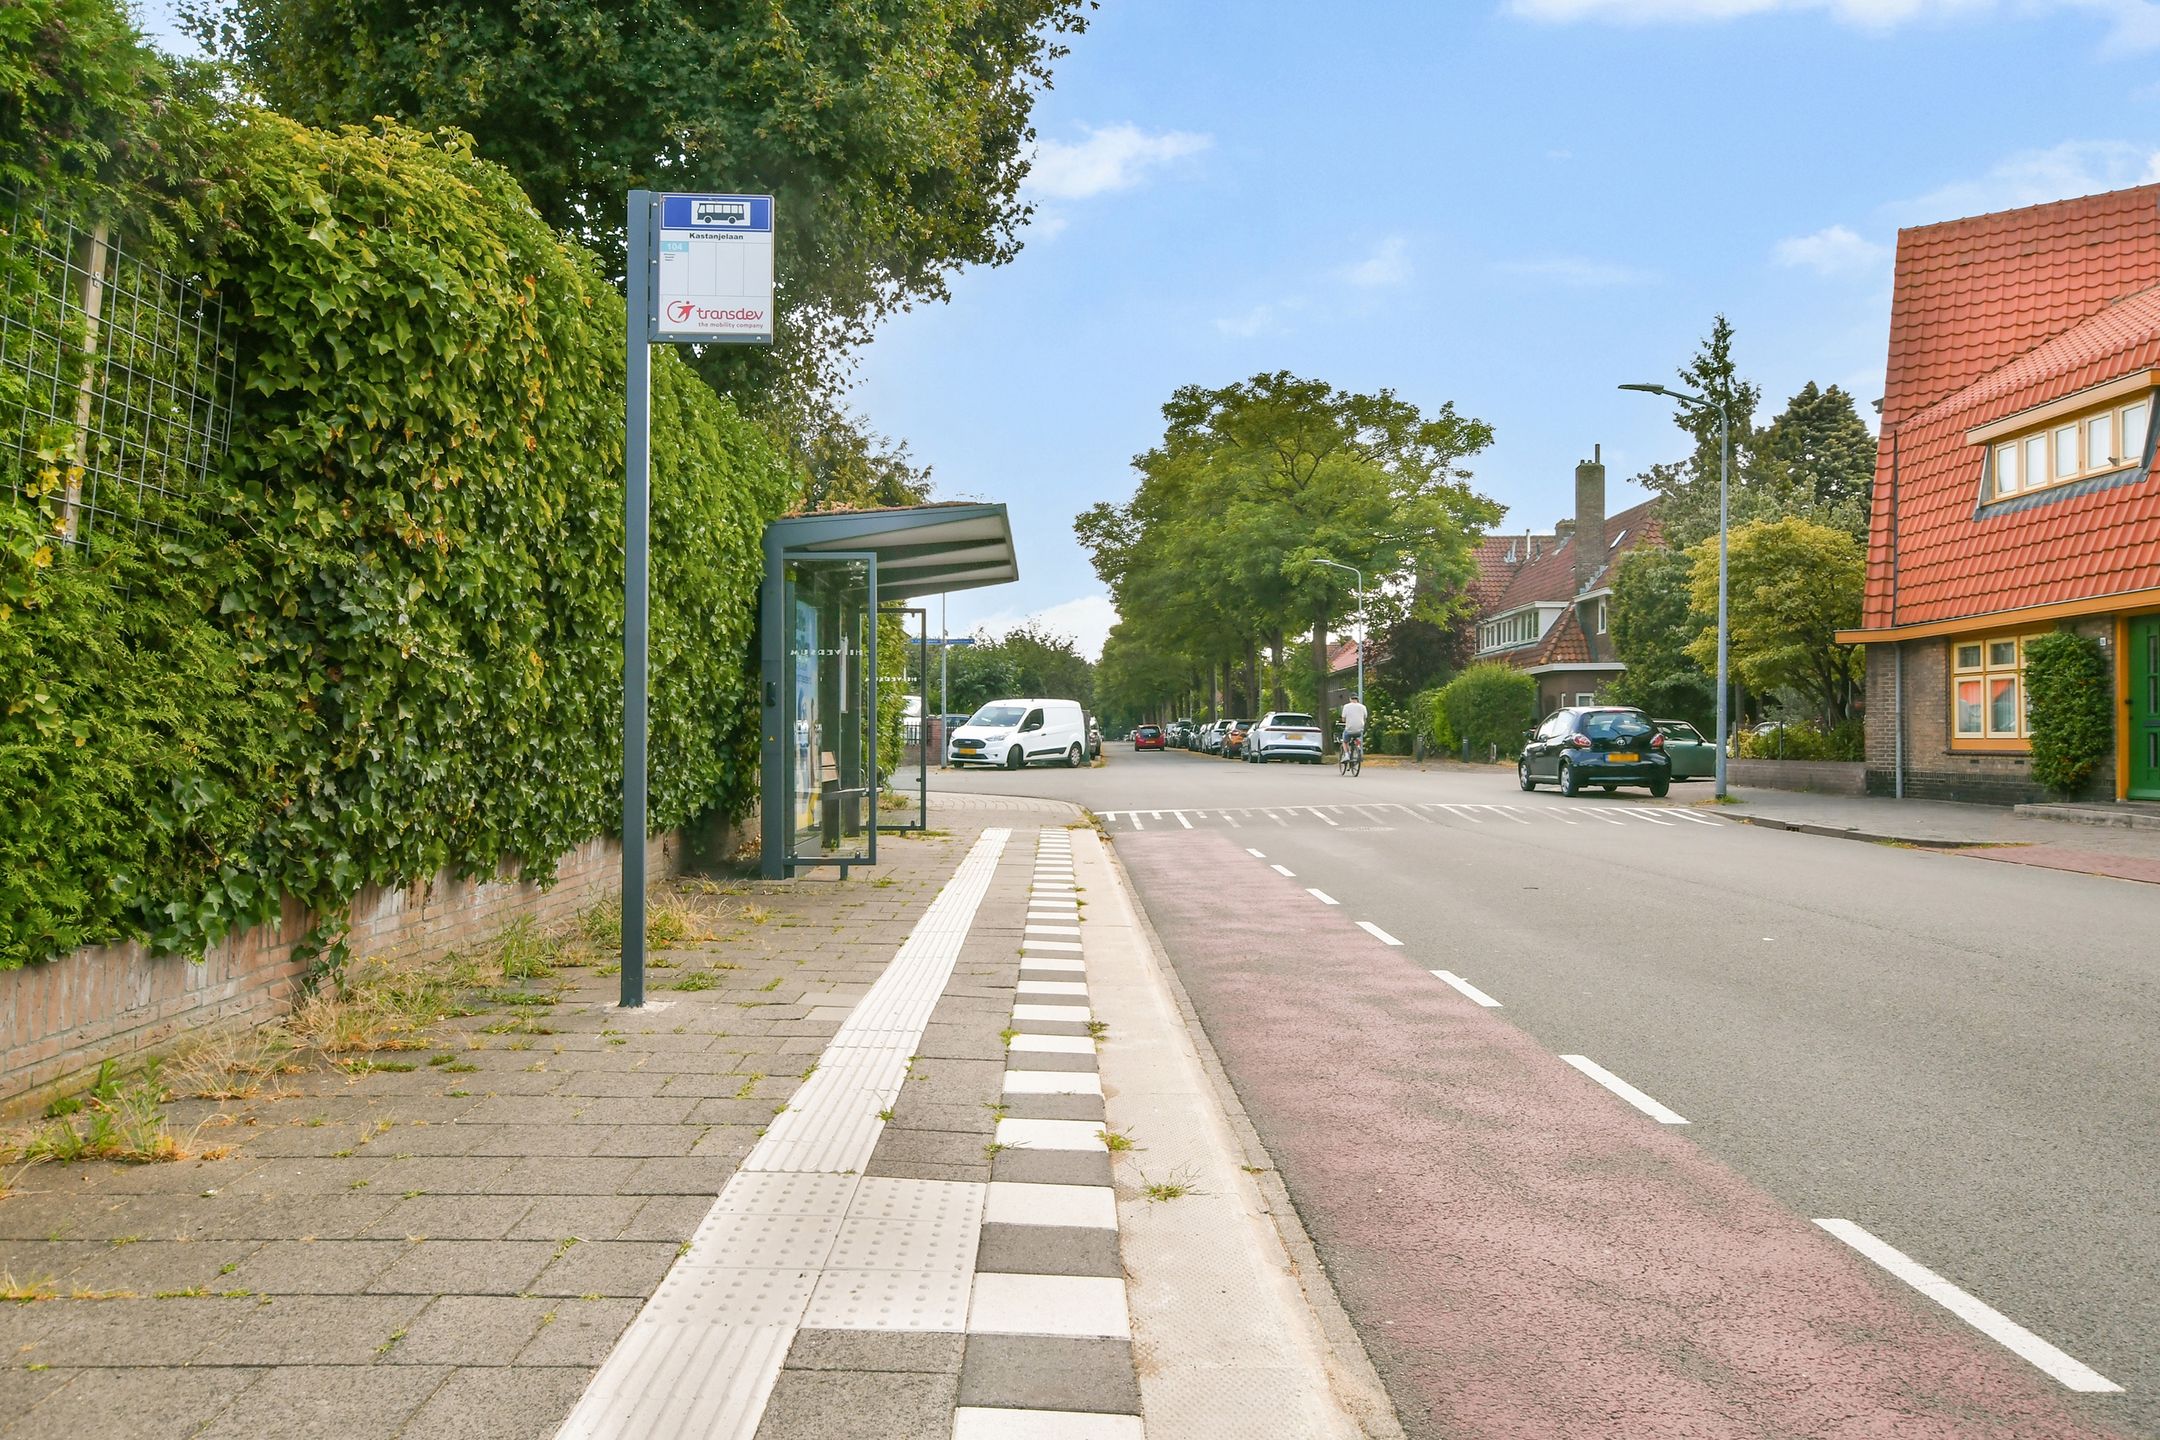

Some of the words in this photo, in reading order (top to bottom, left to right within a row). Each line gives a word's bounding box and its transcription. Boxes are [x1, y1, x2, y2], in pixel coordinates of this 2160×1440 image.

[689, 232, 744, 241] Kastanjelaan
[667, 243, 683, 251] 104
[696, 307, 764, 320] transdev
[710, 321, 735, 329] mobility
[736, 322, 764, 330] company
